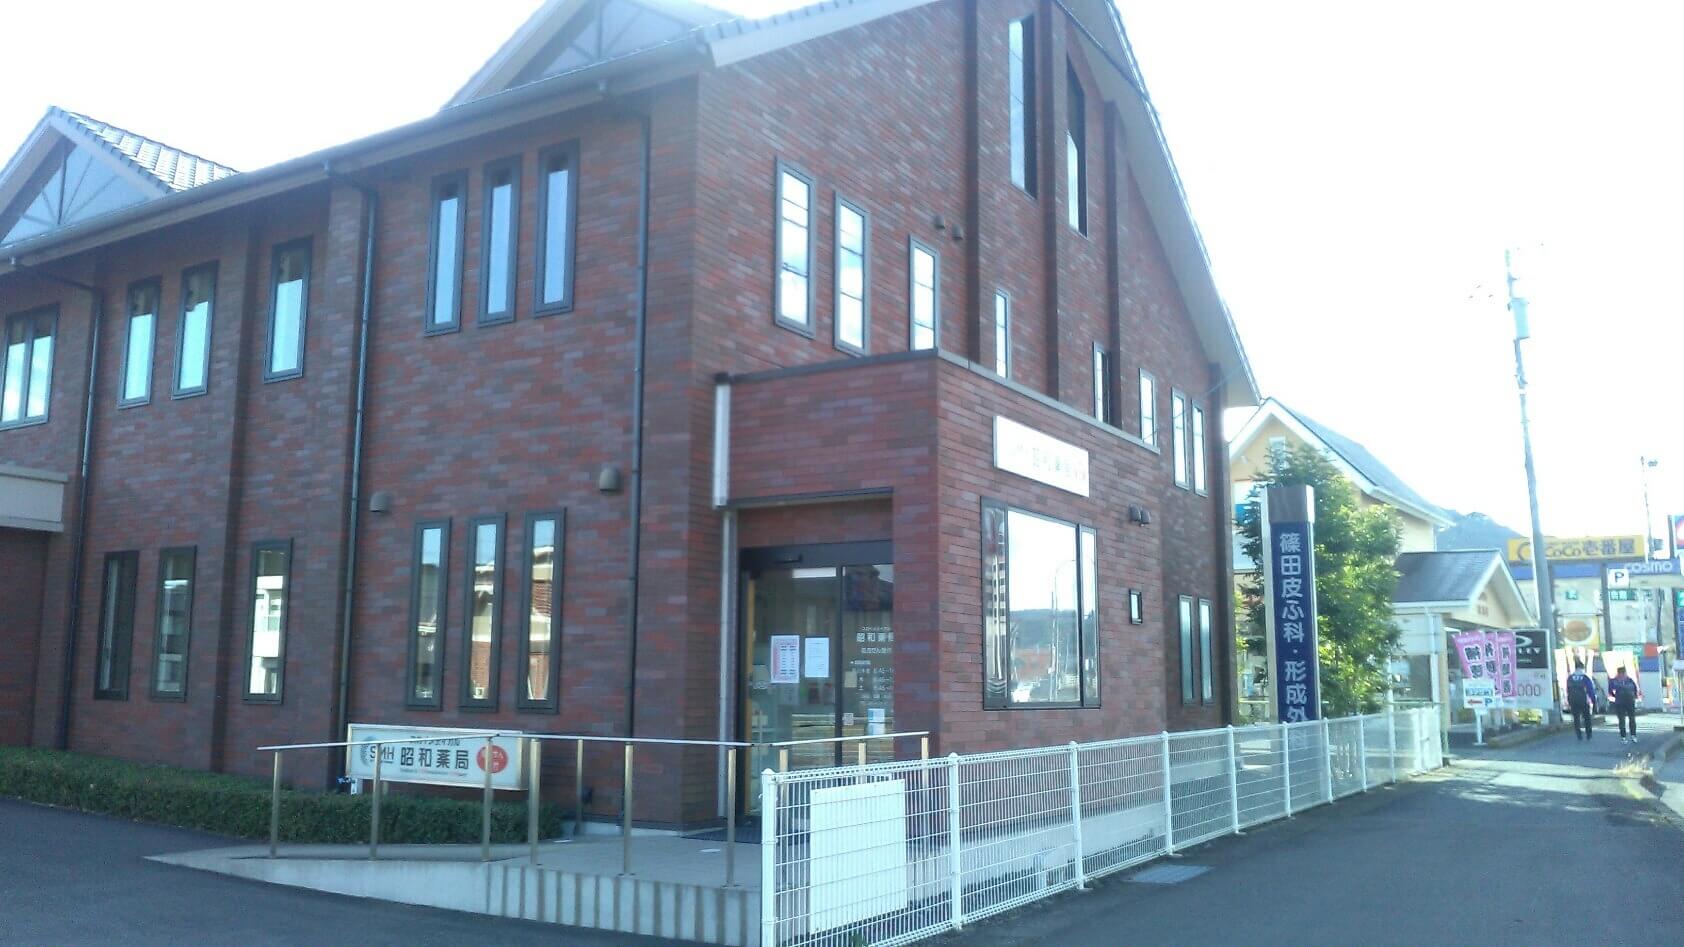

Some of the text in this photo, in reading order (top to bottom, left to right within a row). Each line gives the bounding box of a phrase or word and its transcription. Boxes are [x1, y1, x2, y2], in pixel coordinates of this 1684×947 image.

[1614, 571, 1625, 583] P
[400, 746, 470, 770] 昭和薬局
